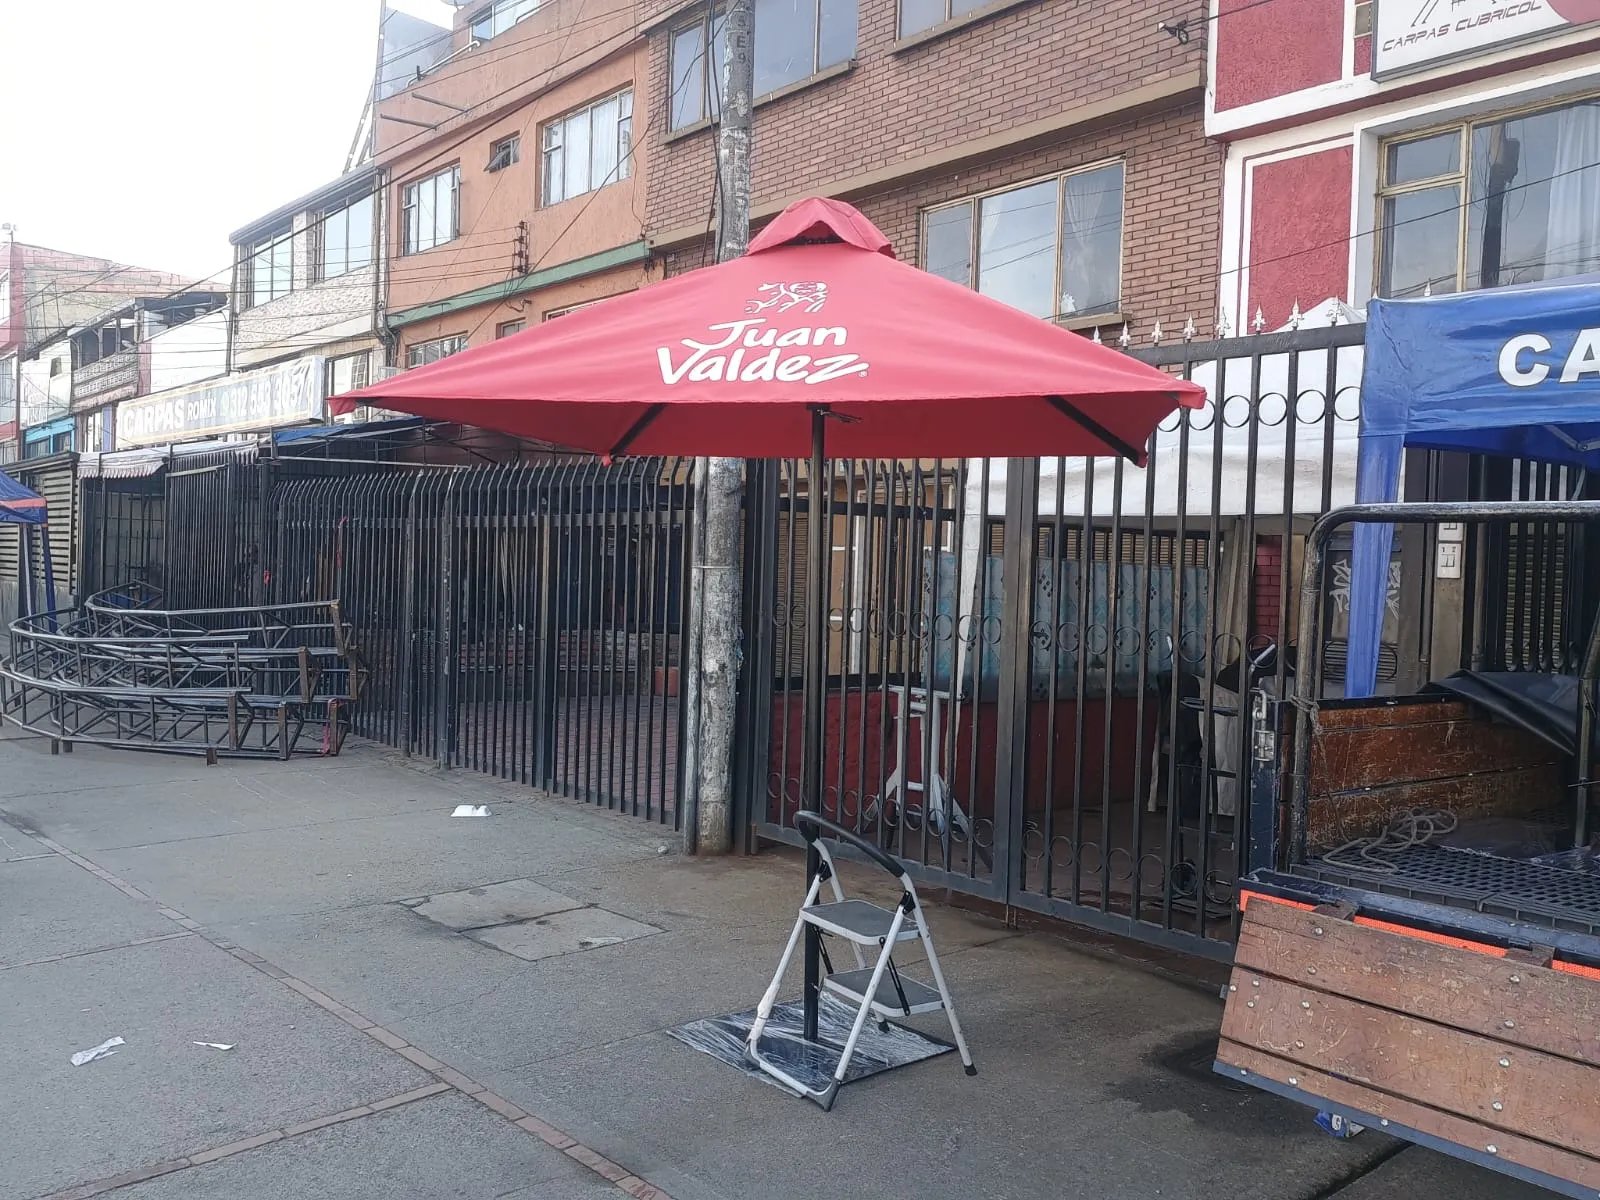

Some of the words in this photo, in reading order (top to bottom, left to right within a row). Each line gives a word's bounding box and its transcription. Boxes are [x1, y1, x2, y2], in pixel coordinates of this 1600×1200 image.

[1382, 23, 1451, 52] CARPAS
[1455, 0, 1542, 32] CUBRICOL
[680, 318, 848, 350] Juan
[656, 347, 870, 385] Valdez
[123, 400, 184, 438] CARPAS
